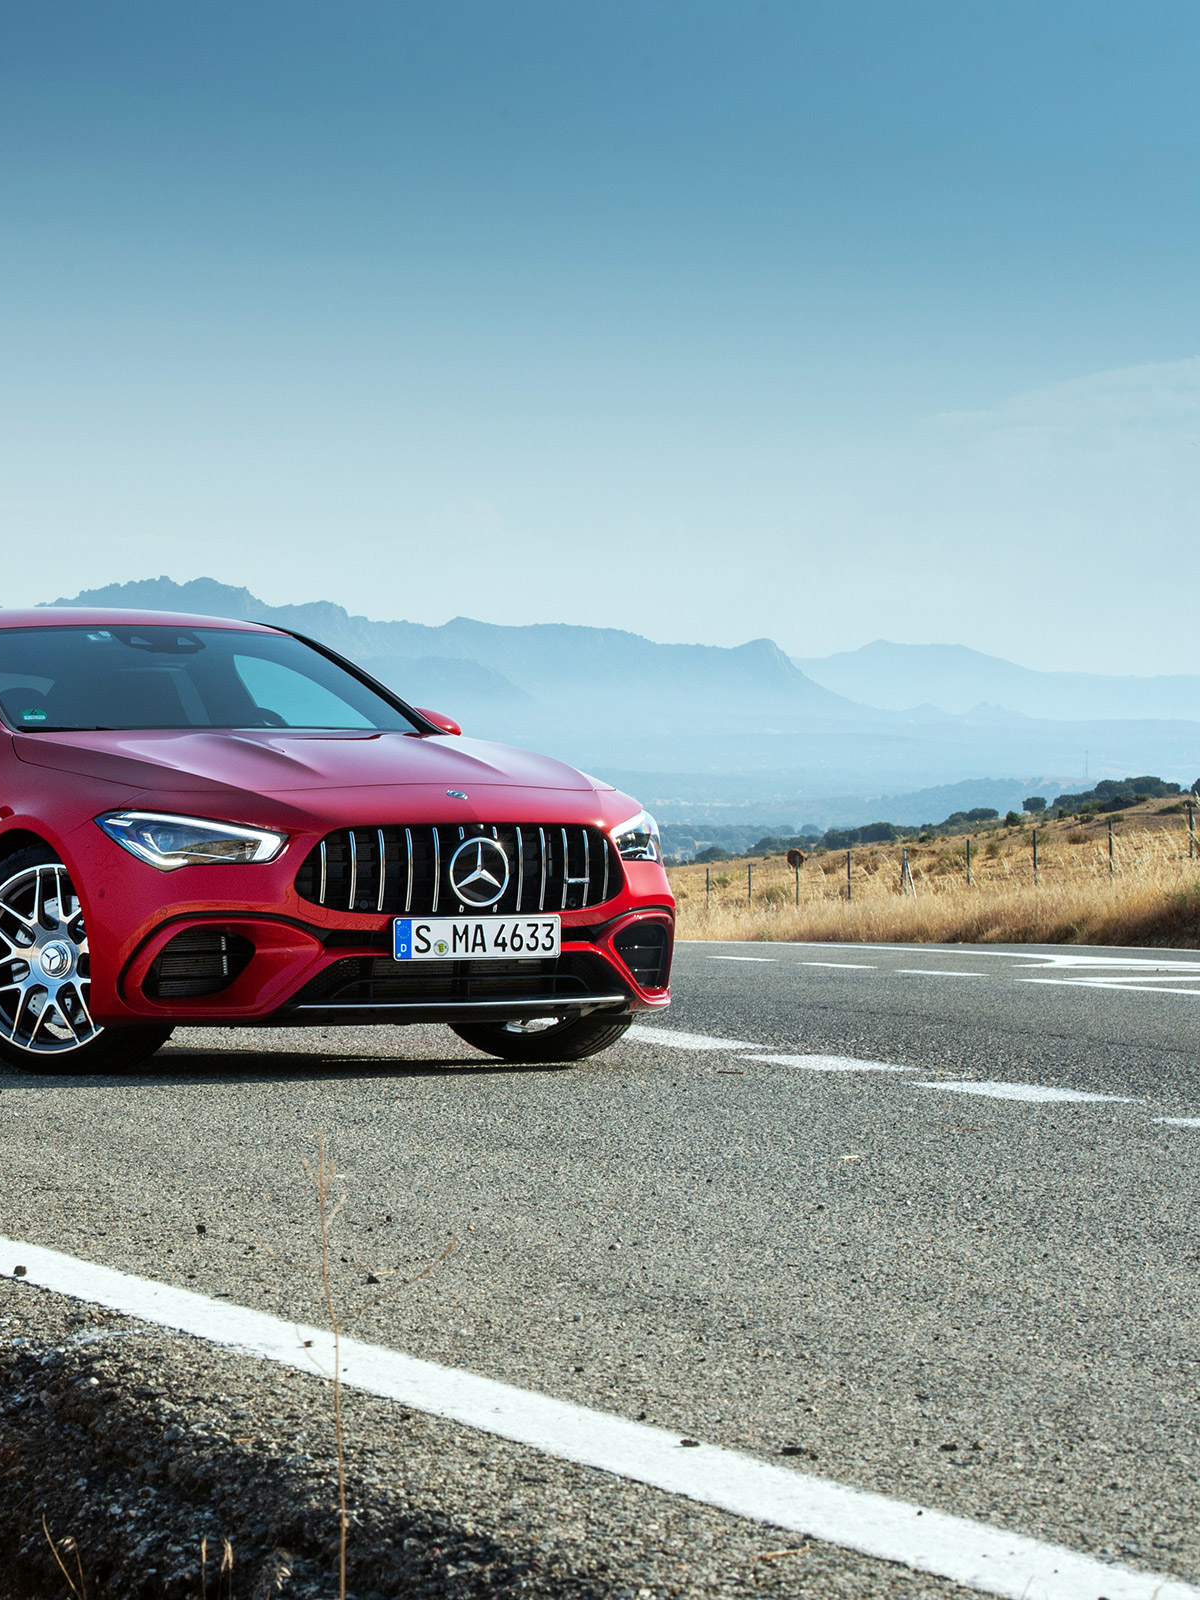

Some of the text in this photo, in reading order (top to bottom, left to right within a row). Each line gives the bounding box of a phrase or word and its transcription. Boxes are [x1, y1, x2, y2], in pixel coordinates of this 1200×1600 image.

[415, 923, 555, 953] S MA 4633
[401, 944, 407, 952] D
